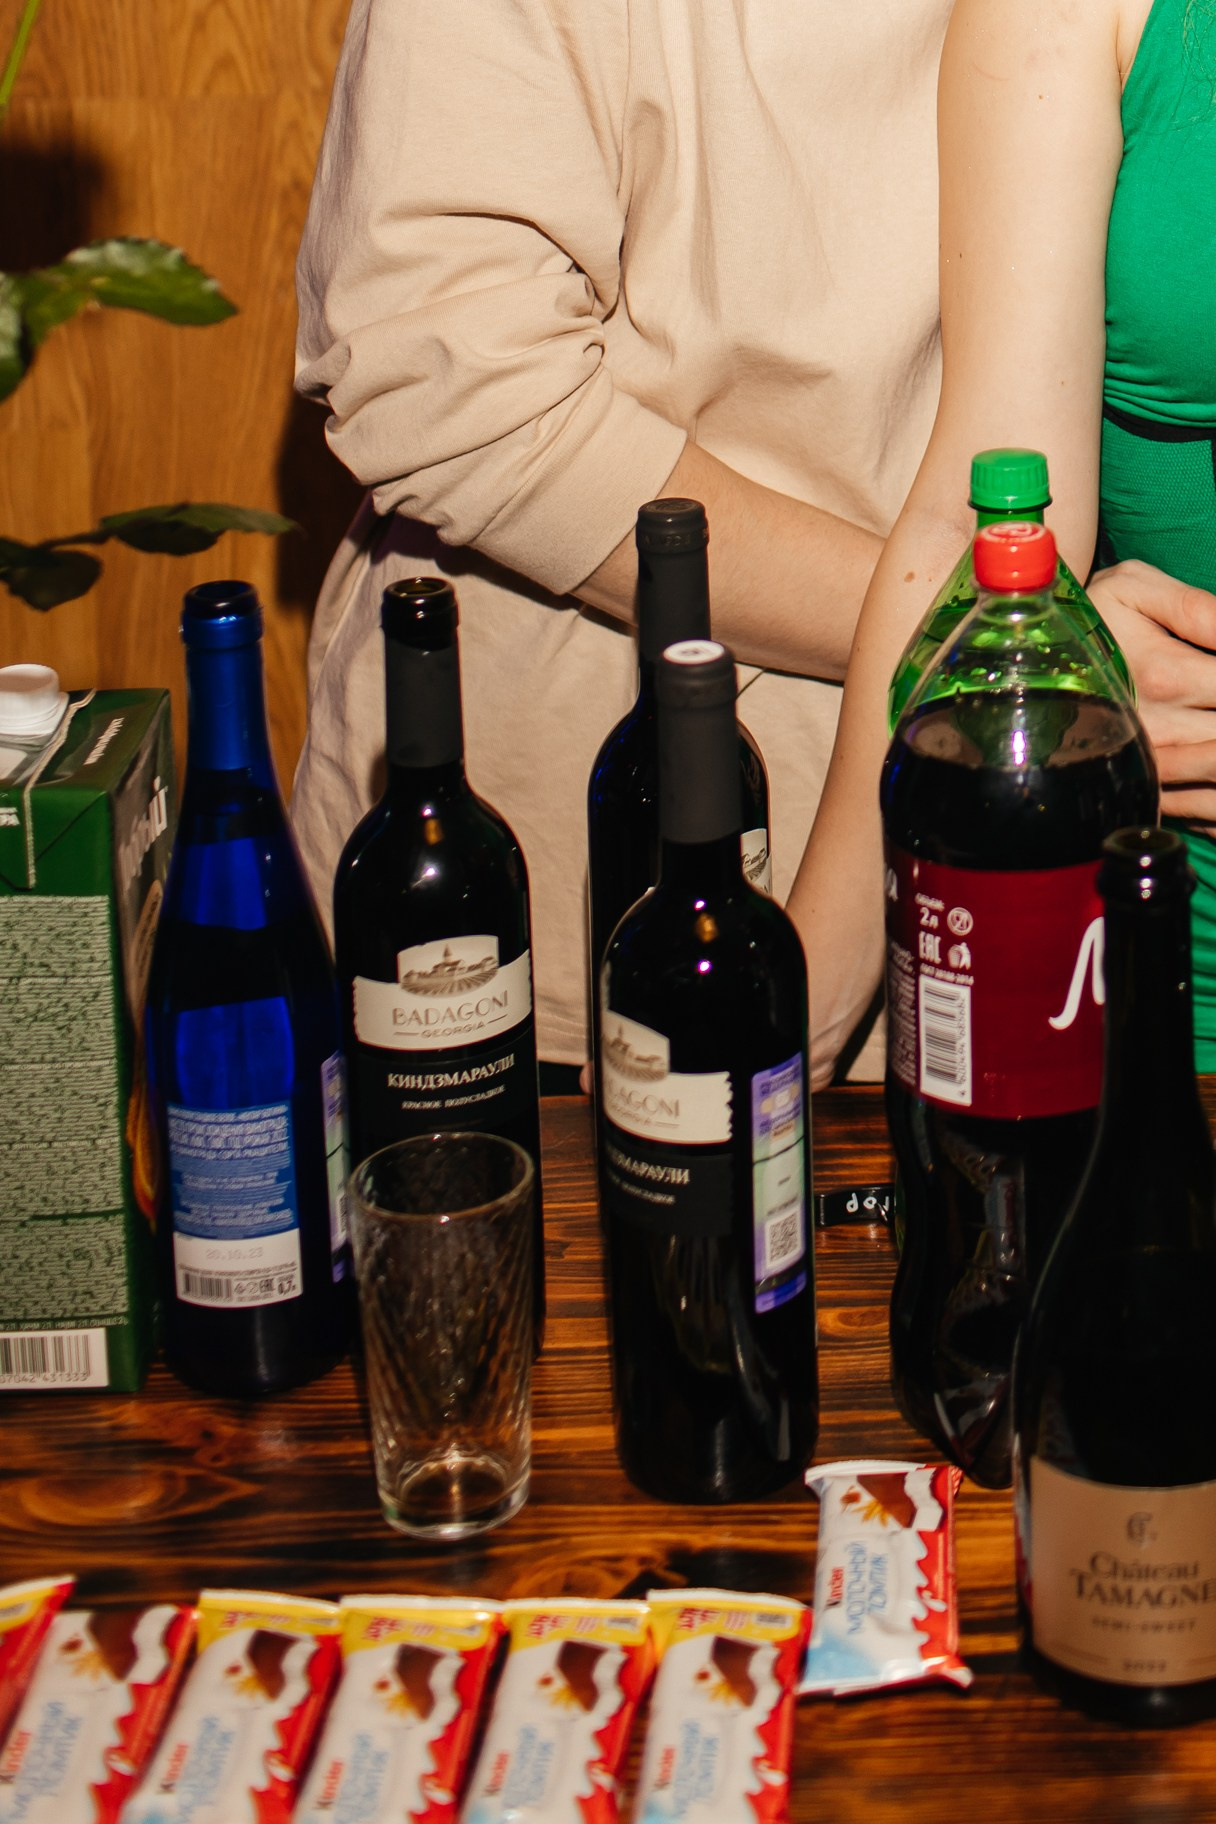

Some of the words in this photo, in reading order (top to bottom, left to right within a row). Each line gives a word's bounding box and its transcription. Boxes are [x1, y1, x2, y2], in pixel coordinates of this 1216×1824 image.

[392, 990, 509, 1026] BADAGONI
[421, 1020, 486, 1038] GEORGIA
[387, 1053, 515, 1091] КИНДЗМАРАУЛИ
